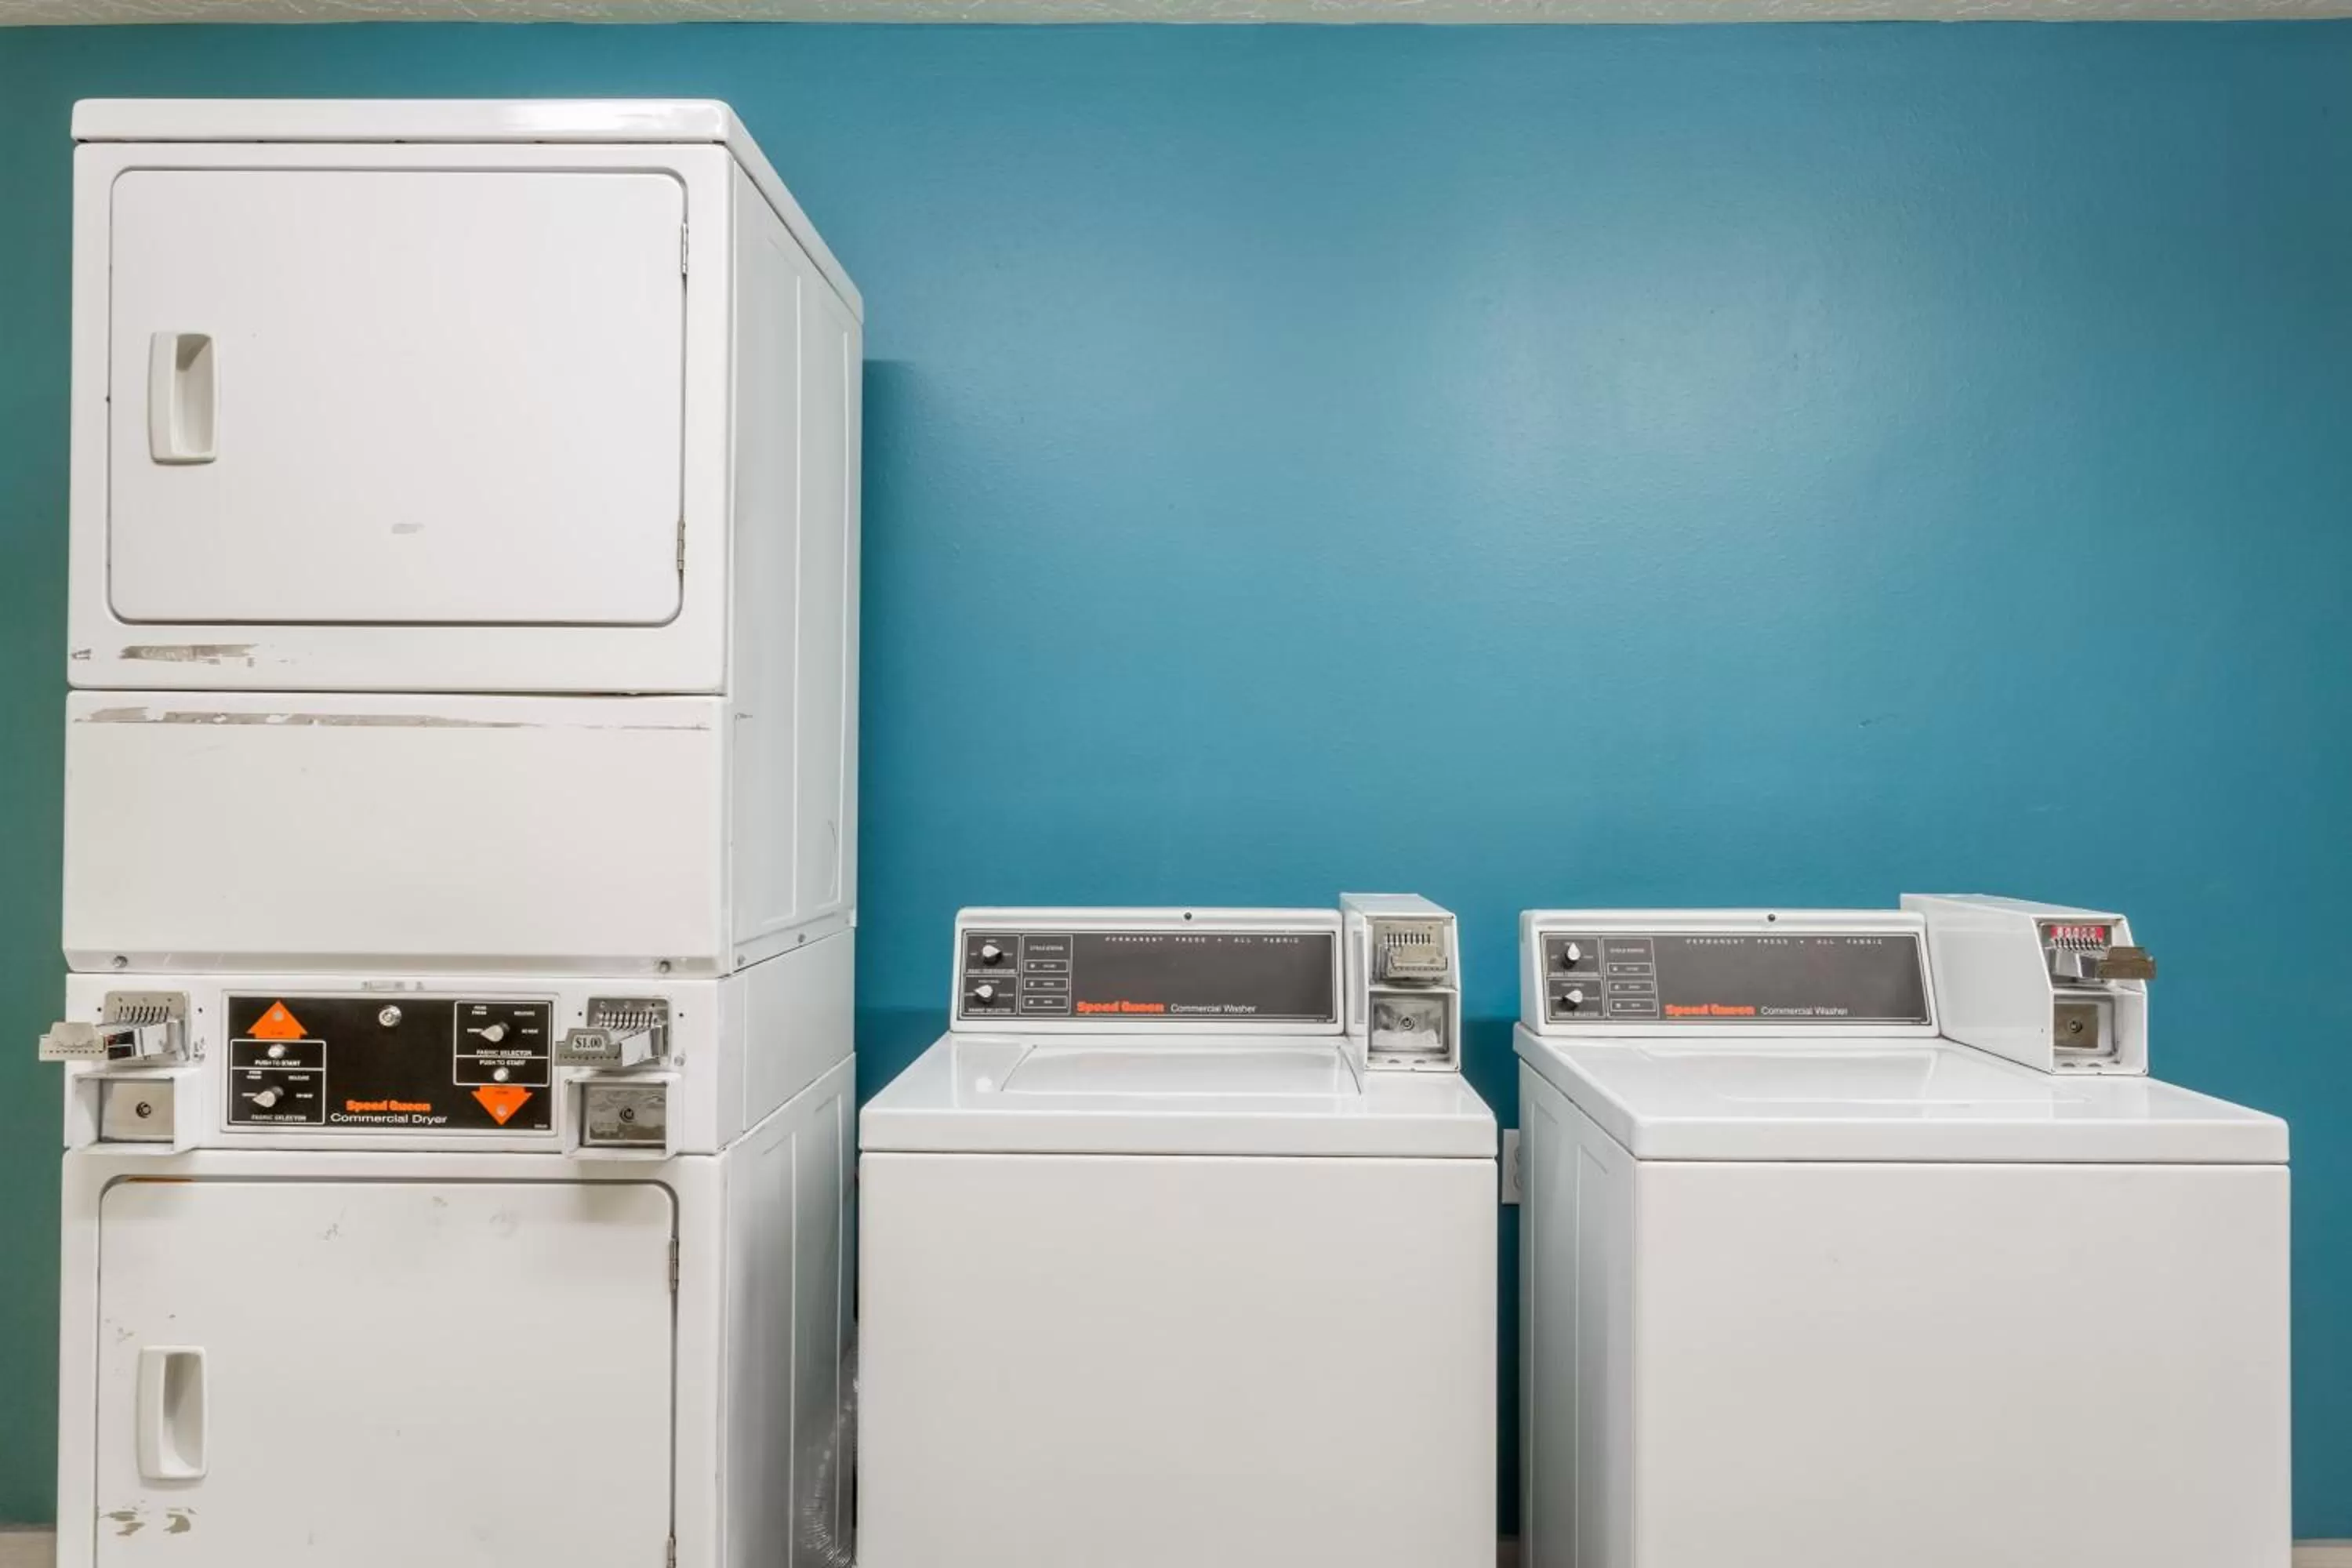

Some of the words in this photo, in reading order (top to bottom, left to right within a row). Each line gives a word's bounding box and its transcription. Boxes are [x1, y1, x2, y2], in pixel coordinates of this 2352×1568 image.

[1076, 1000, 1120, 1014] Speed
[1121, 1000, 1164, 1014] Queen
[1170, 1003, 1222, 1013] Commercial
[1224, 1004, 1256, 1013] Washer
[1664, 1004, 1709, 1016] Speed
[1761, 1006, 1813, 1016] Commercial
[1815, 1006, 1848, 1016] Washer
[574, 1036, 602, 1049] $1.00
[345, 1099, 388, 1112] Speed
[389, 1099, 431, 1111] Queen
[330, 1112, 408, 1123] Commercial
[412, 1114, 448, 1125] Dryer
